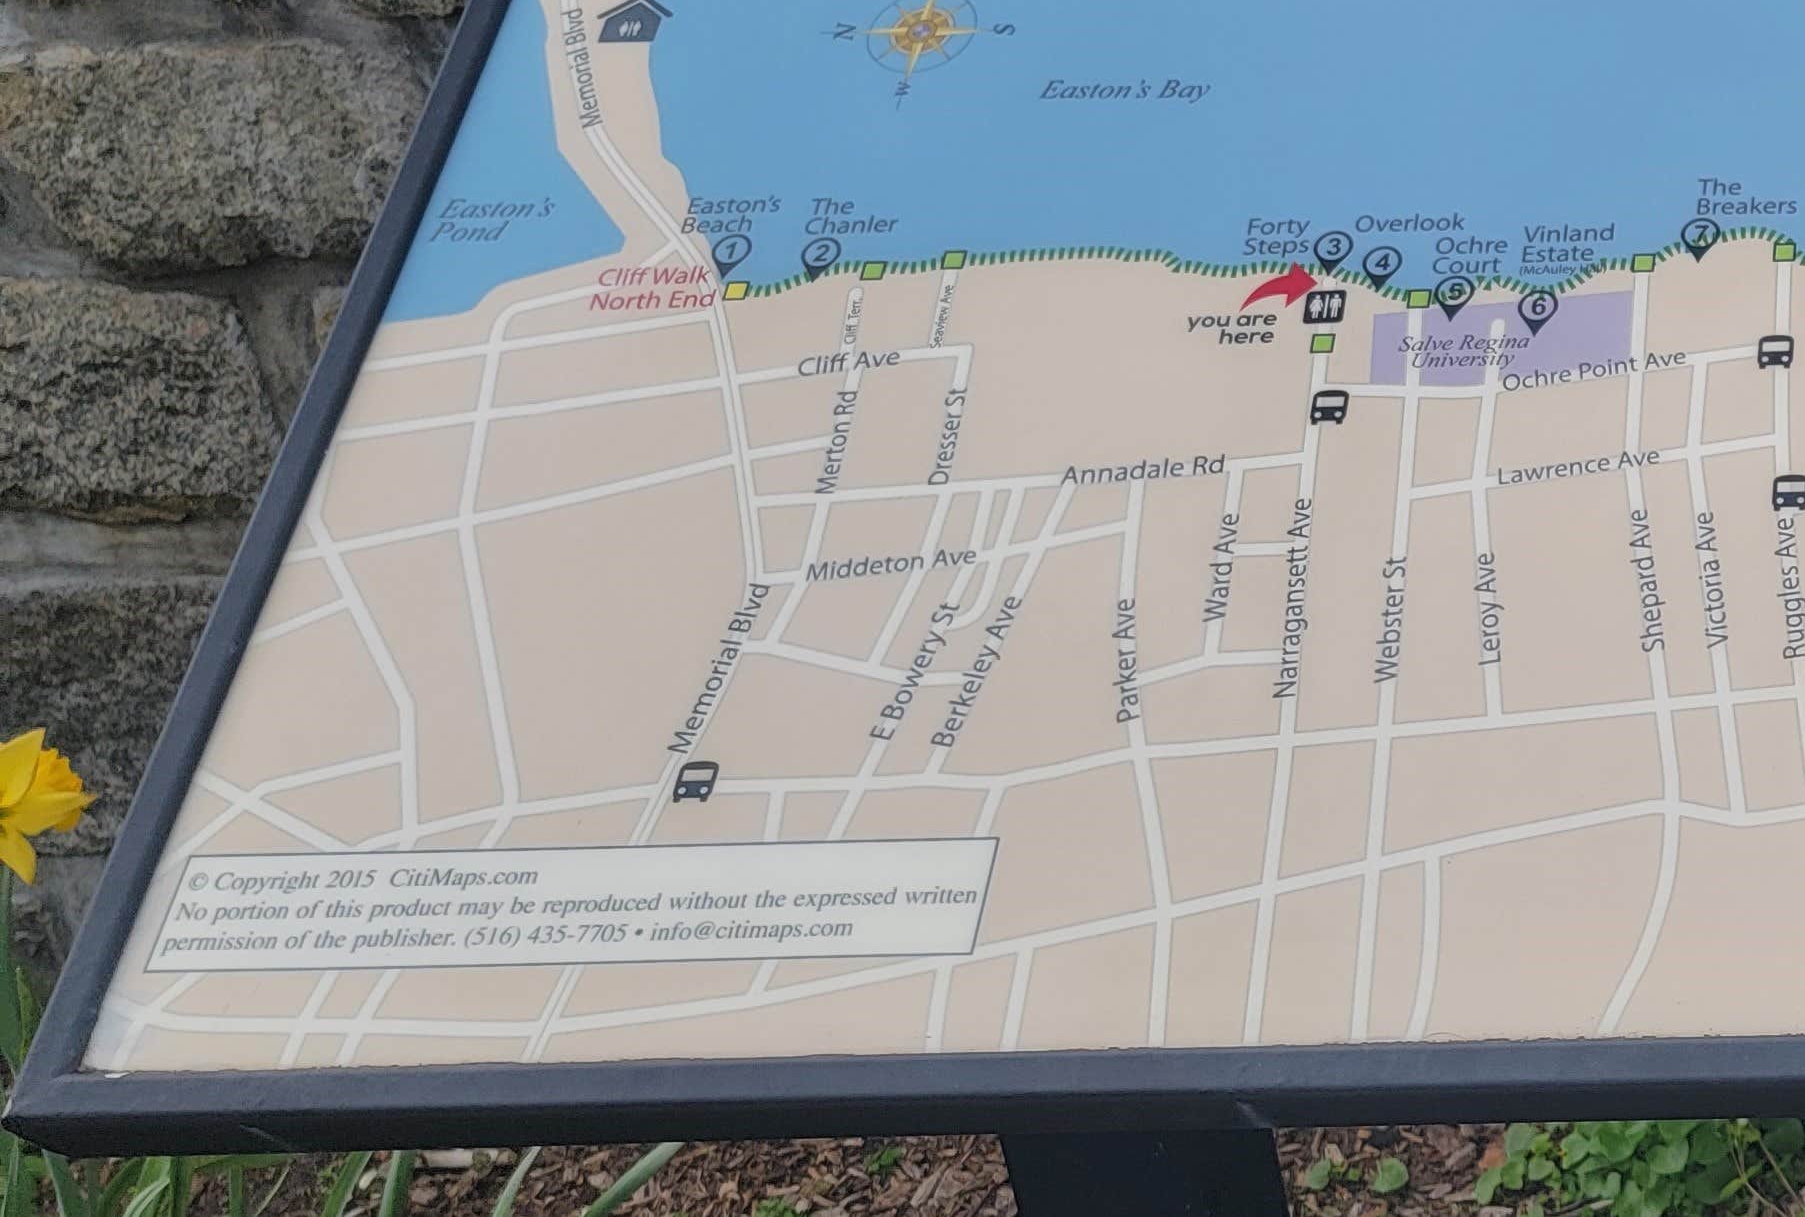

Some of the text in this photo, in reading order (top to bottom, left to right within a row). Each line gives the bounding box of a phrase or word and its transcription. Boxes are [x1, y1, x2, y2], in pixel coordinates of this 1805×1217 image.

[561, 8, 602, 130] Memorial Blvd
[1039, 78, 1212, 102] Easton's Bay
[1697, 177, 1742, 197] The
[438, 197, 556, 220] Easton's
[687, 194, 782, 216] Easton's
[811, 197, 855, 216] The
[1696, 196, 1798, 216] Breakers
[429, 221, 509, 244] Pond
[680, 214, 752, 235] Beach
[804, 214, 900, 236] Chanler
[1246, 217, 1311, 238] Forty
[1354, 212, 1465, 233] Overlook
[1523, 222, 1616, 244] Vinland
[1242, 234, 1317, 258] Steps
[1434, 235, 1508, 255] Ochre
[1520, 245, 1595, 264] Estate
[597, 264, 711, 287] Cliff Walk
[1431, 256, 1502, 277] Court
[589, 288, 722, 311] North End
[1187, 309, 1278, 332] you are
[1218, 328, 1275, 345] here
[1396, 332, 1531, 355] Salve Regina
[799, 349, 900, 378] Cliff Ave
[1411, 348, 1521, 371] University
[1503, 351, 1686, 393] Ochre Point Ave
[1063, 454, 1225, 485] Annadale Rd
[1498, 449, 1659, 486] Lawrence Ave
[1775, 518, 1794, 558] Ave
[806, 548, 976, 582] Middeton Ave
[1274, 499, 1311, 698] Narragansett Ave
[1375, 557, 1406, 683] Webster St
[668, 583, 770, 755] Memorial Blvd
[213, 870, 321, 895] Copyright
[324, 869, 378, 889] 2015
[388, 867, 539, 891] CitiMaps.com
[160, 931, 279, 957] permission
[283, 929, 313, 950] of
[312, 929, 348, 950] the
[349, 927, 456, 954] publisher.
[463, 925, 522, 949] (516)
[526, 922, 630, 945] 435-7705
